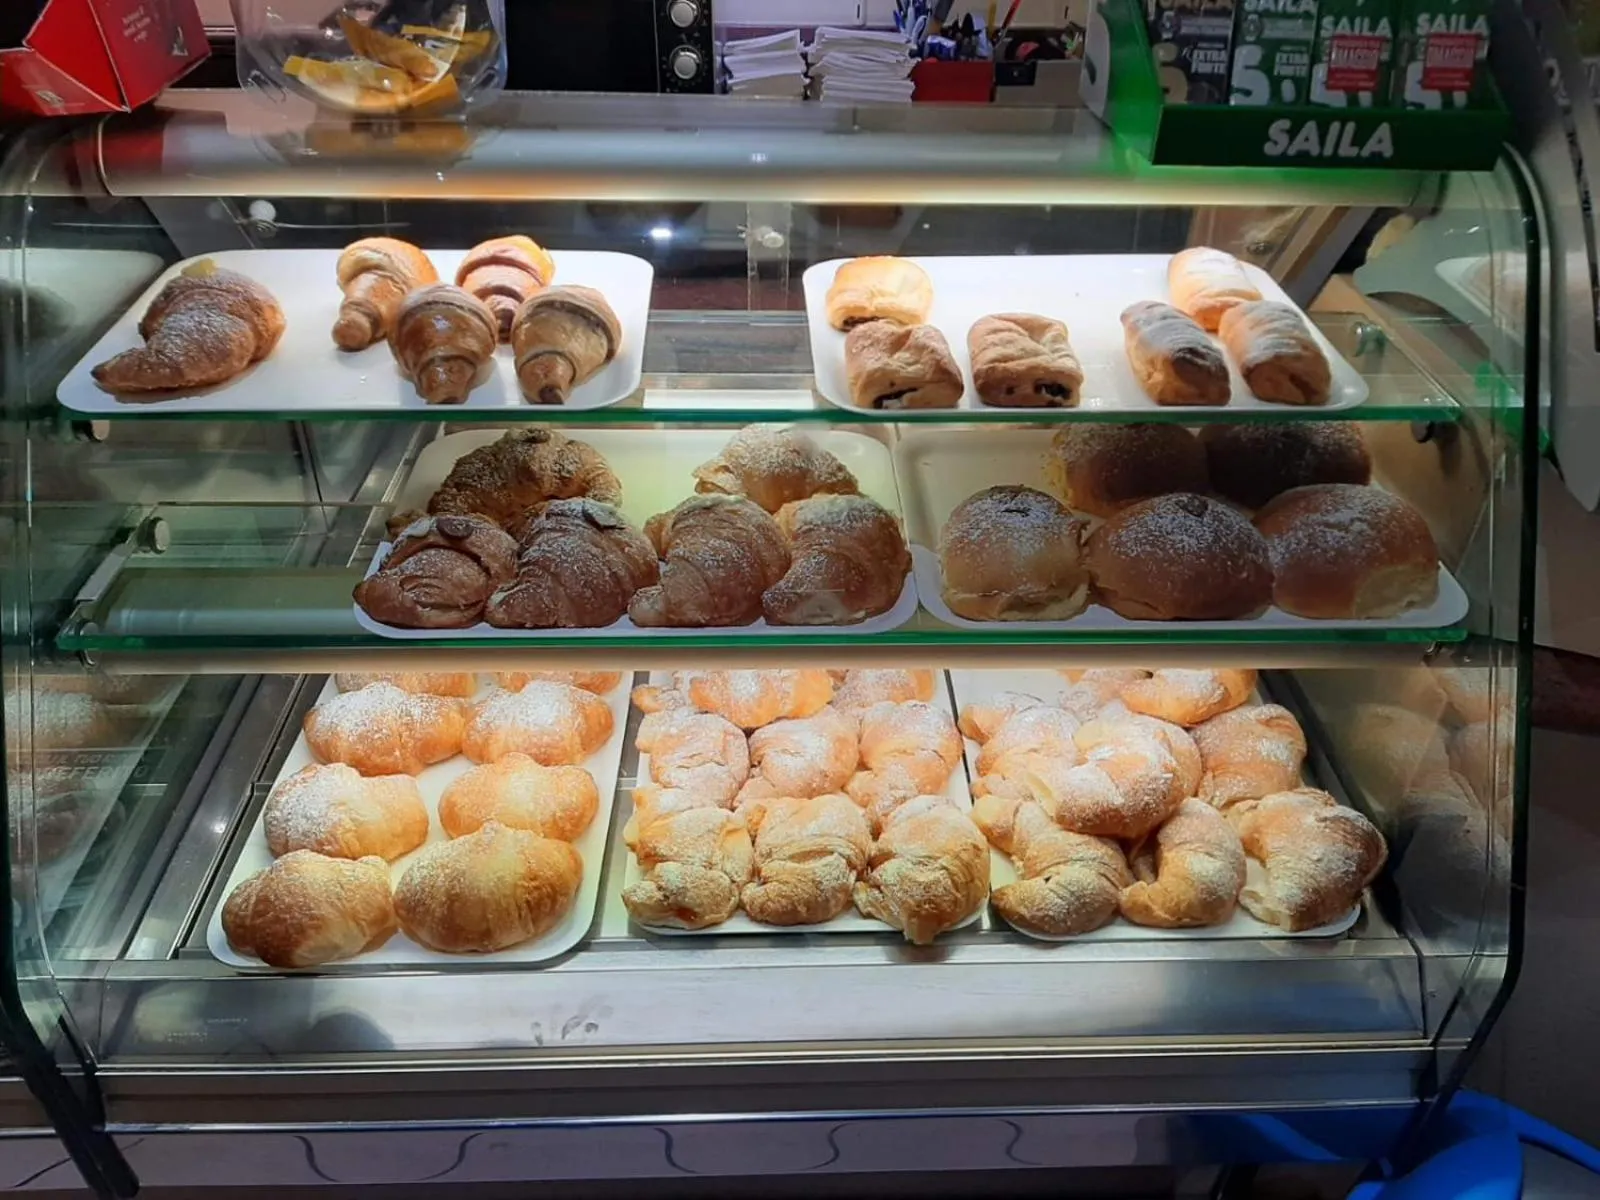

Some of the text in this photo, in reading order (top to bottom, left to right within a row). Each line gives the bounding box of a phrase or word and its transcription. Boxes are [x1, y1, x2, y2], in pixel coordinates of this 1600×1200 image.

[1320, 16, 1393, 37] SAILA
[1417, 13, 1490, 36] SAILA
[1192, 49, 1227, 62] EXTRA
[1276, 52, 1309, 65] EXTRA
[1263, 118, 1394, 158] SAILA
